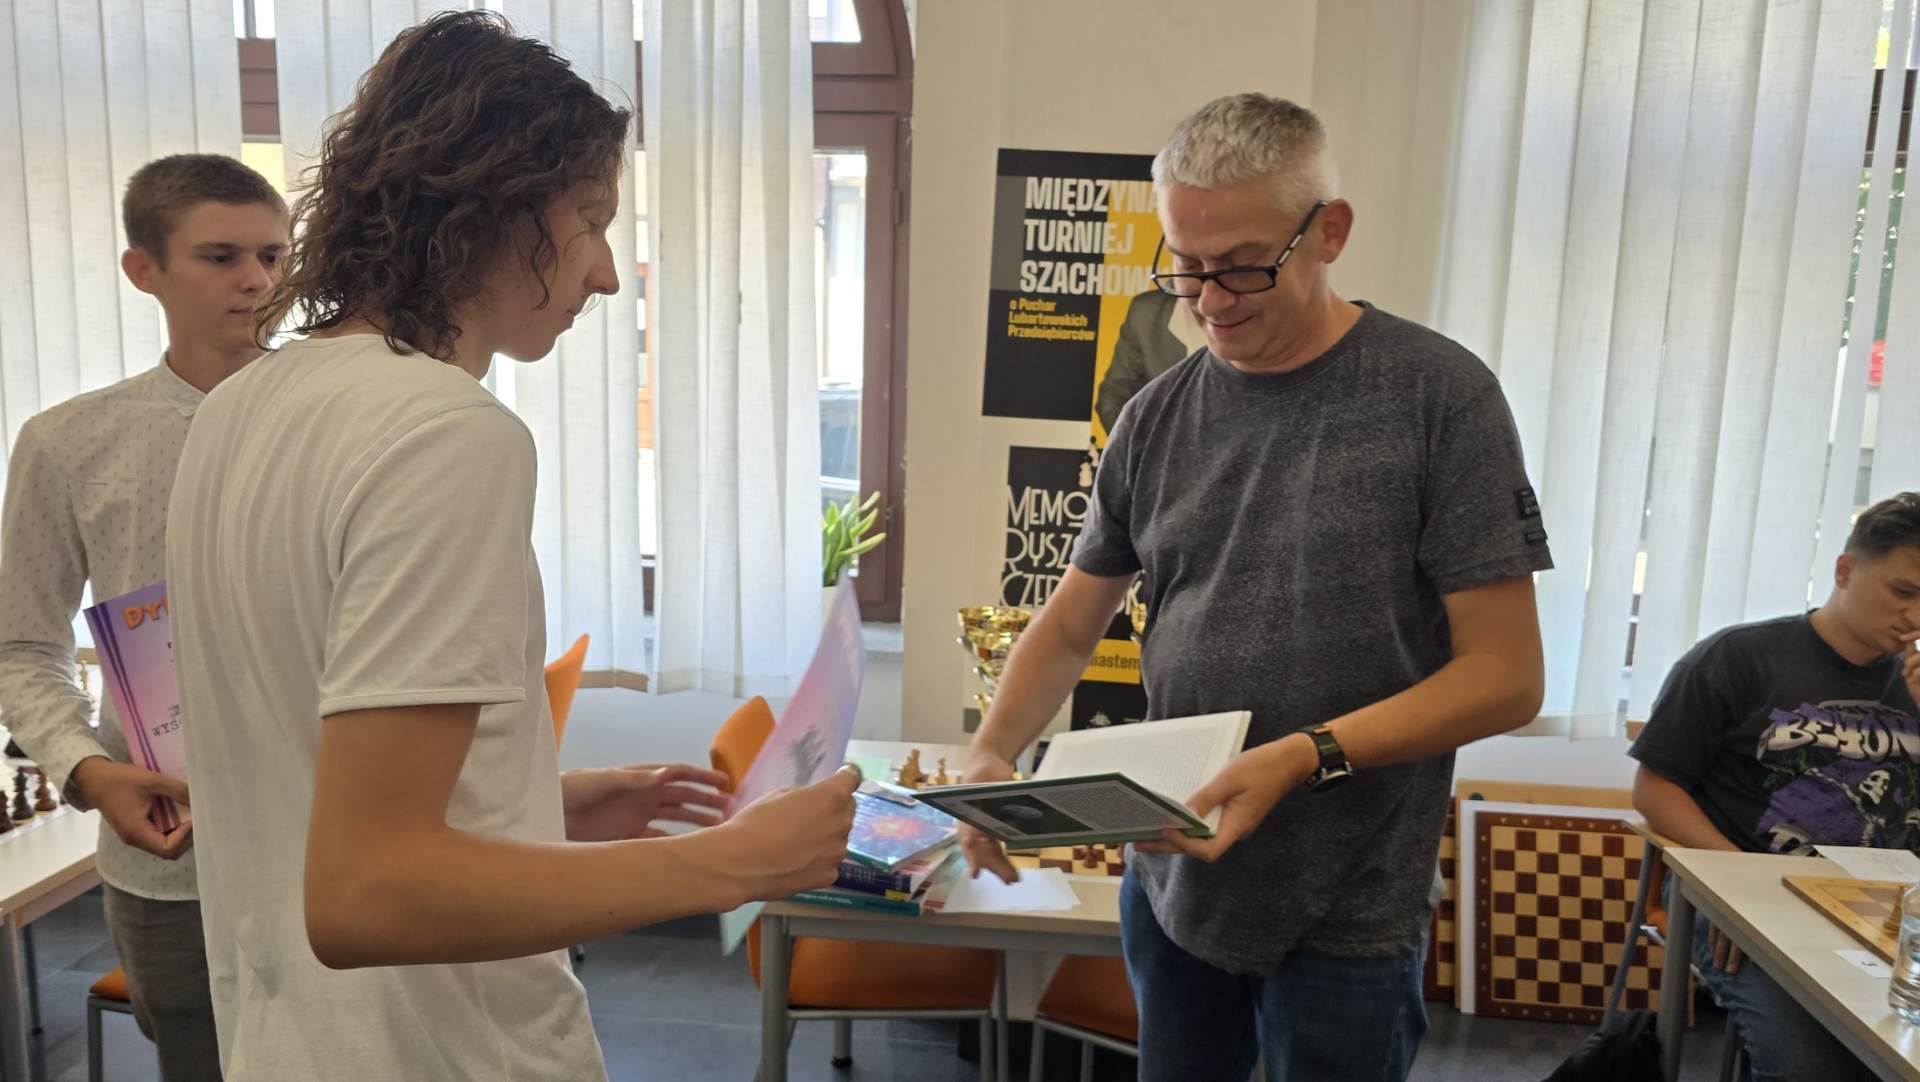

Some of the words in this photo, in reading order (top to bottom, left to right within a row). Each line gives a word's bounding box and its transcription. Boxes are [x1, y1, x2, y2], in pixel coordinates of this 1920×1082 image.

[1024, 219, 1134, 254] TURNIEJ
[1009, 300, 1018, 310] o
[1019, 298, 1057, 312] Puchar
[124, 596, 169, 630] DY
[1089, 652, 1140, 670] iastem
